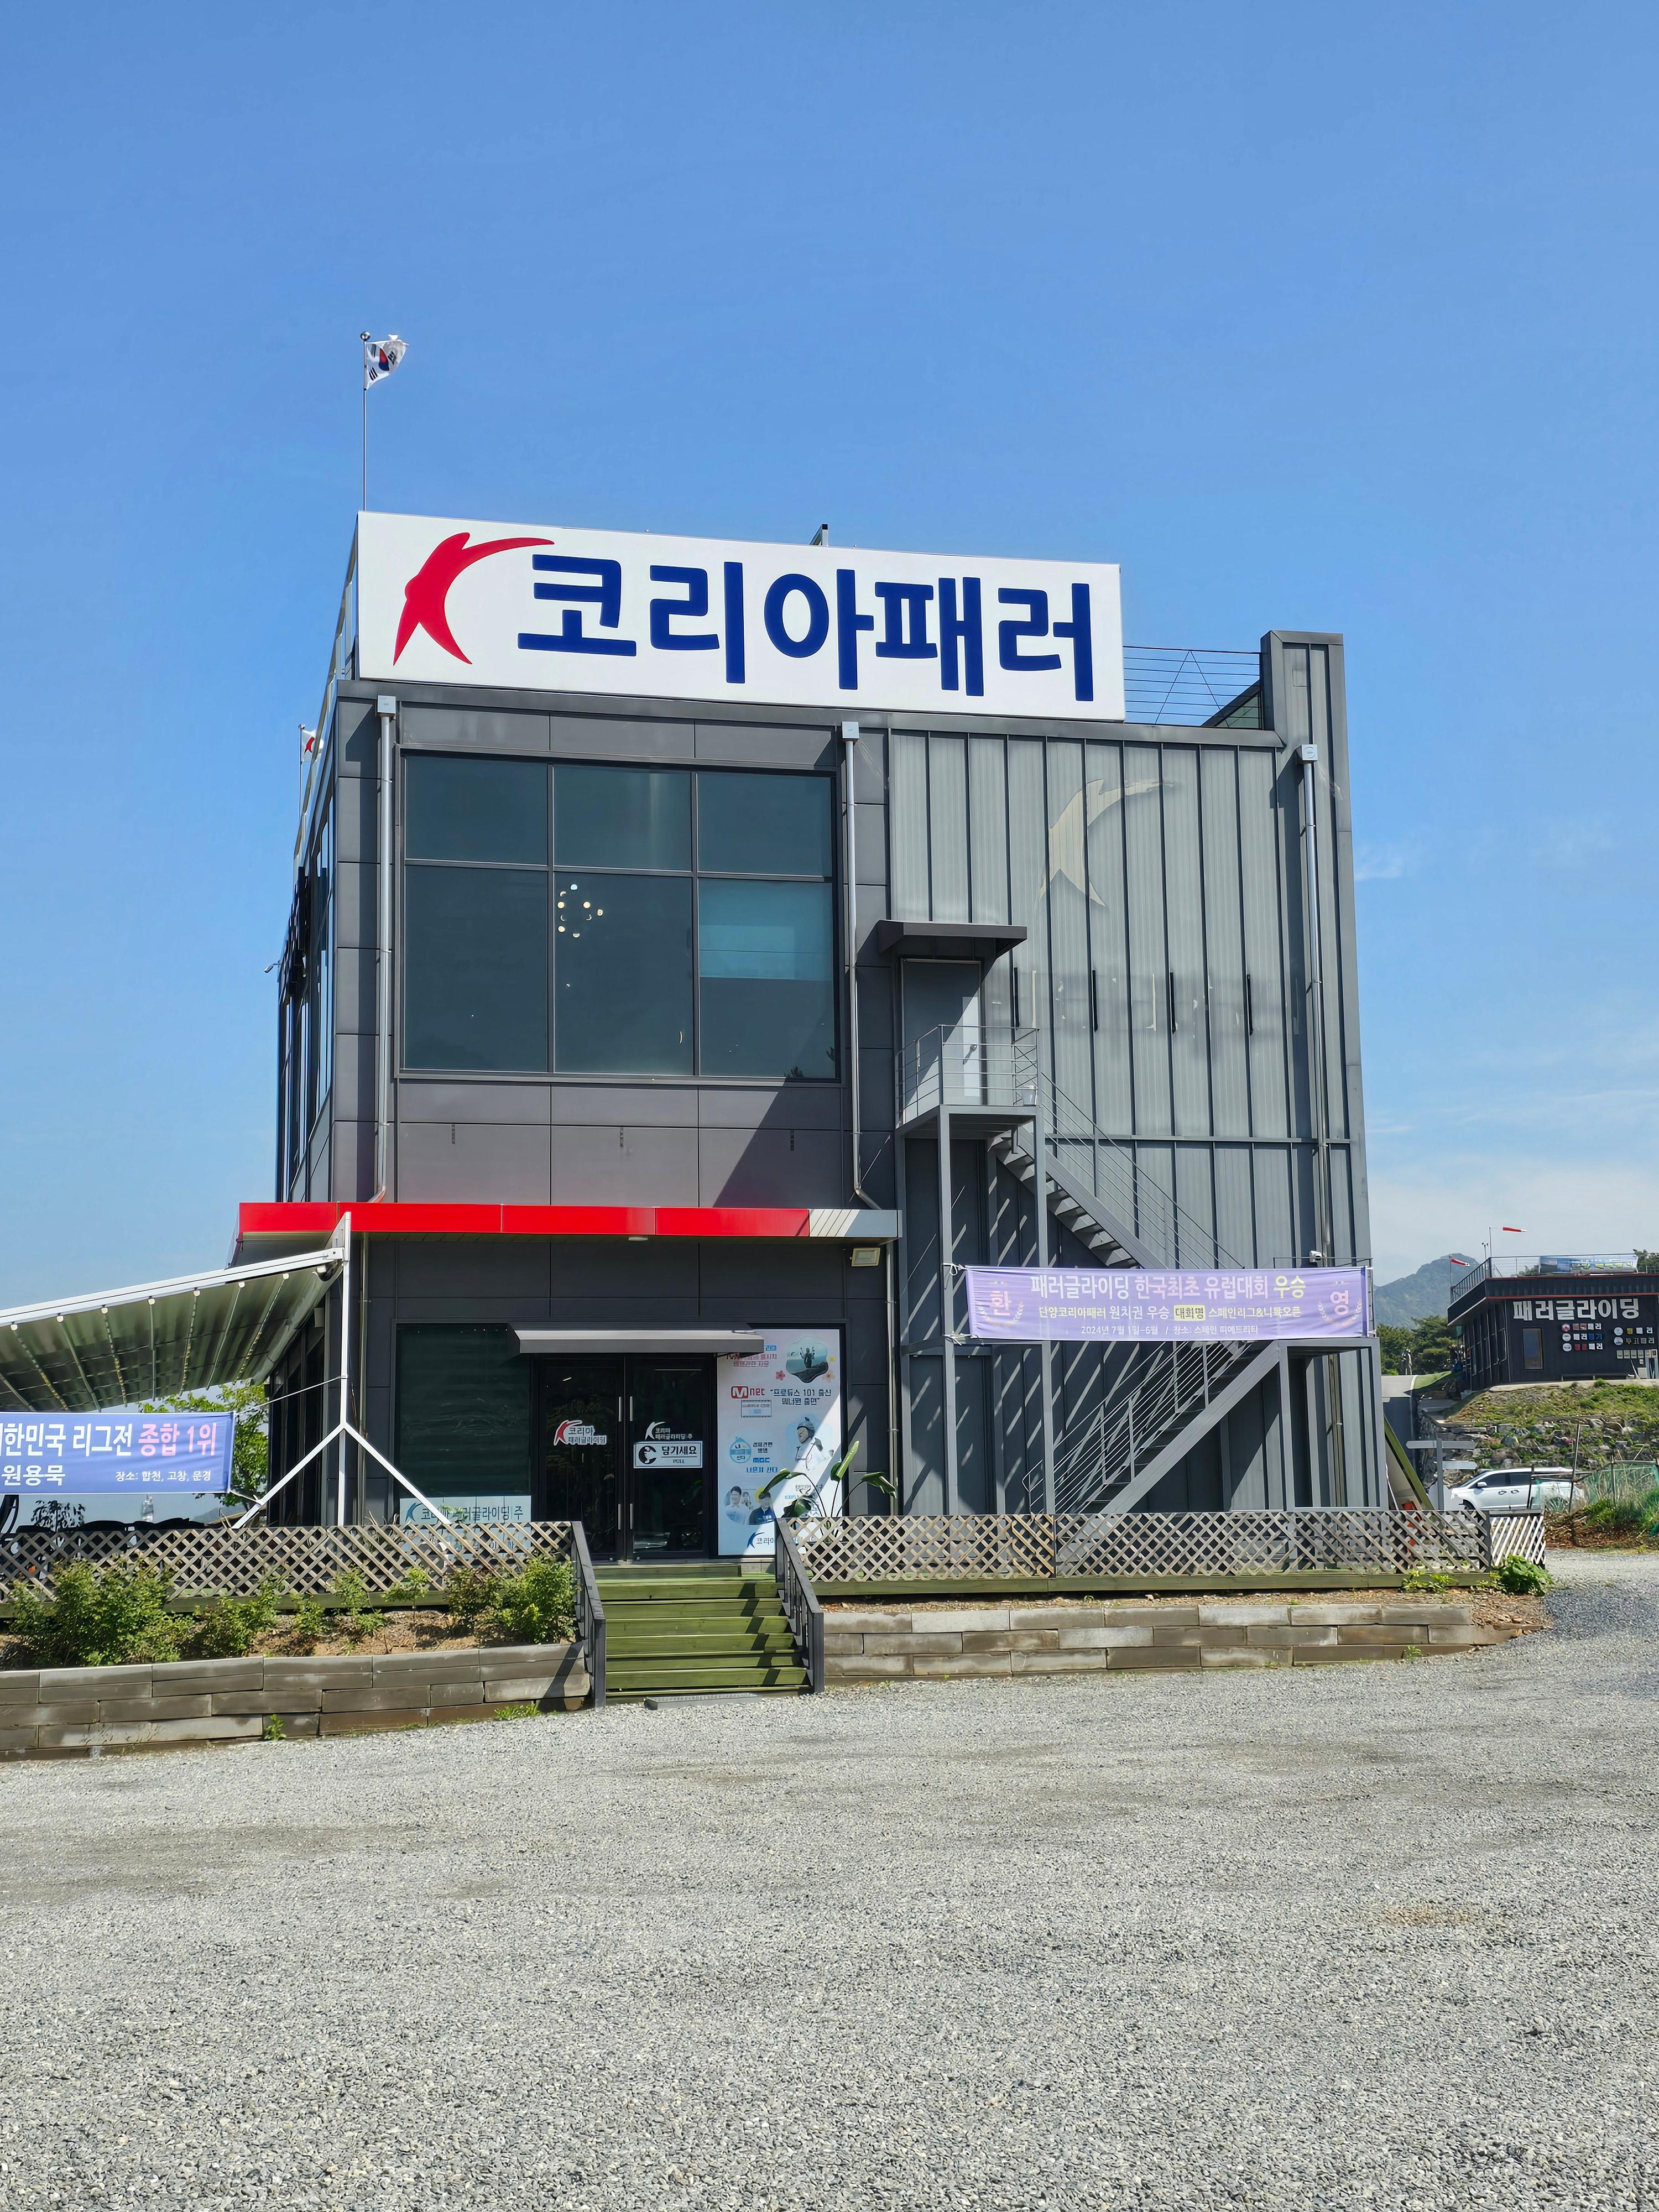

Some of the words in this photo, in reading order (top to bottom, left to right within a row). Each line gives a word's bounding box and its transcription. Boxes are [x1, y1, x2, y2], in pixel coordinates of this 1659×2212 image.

[518, 554, 1093, 701] 코리아패러
[1031, 1274, 1129, 1300] 패러글라이딩
[1135, 1275, 1201, 1300] 한국최초
[1204, 1275, 1268, 1300] 유럽대회
[1274, 1275, 1307, 1299] 우승
[989, 1290, 1012, 1316] 환
[1146, 1306, 1170, 1319] 우승
[1329, 1290, 1349, 1316] 영
[1513, 1298, 1640, 1321] 패러글라이딩
[1081, 1326, 1109, 1335] 2024년
[0, 1422, 66, 1457] 한민국
[73, 1423, 133, 1457] 리그전
[138, 1423, 180, 1457] 종합
[187, 1422, 217, 1456] 1위
[1, 1464, 66, 1486] 원용묵
[116, 1471, 138, 1481] 장소:
[142, 1471, 164, 1482] 합천,
[167, 1471, 189, 1482] 고창,
[192, 1471, 211, 1481] 문경
